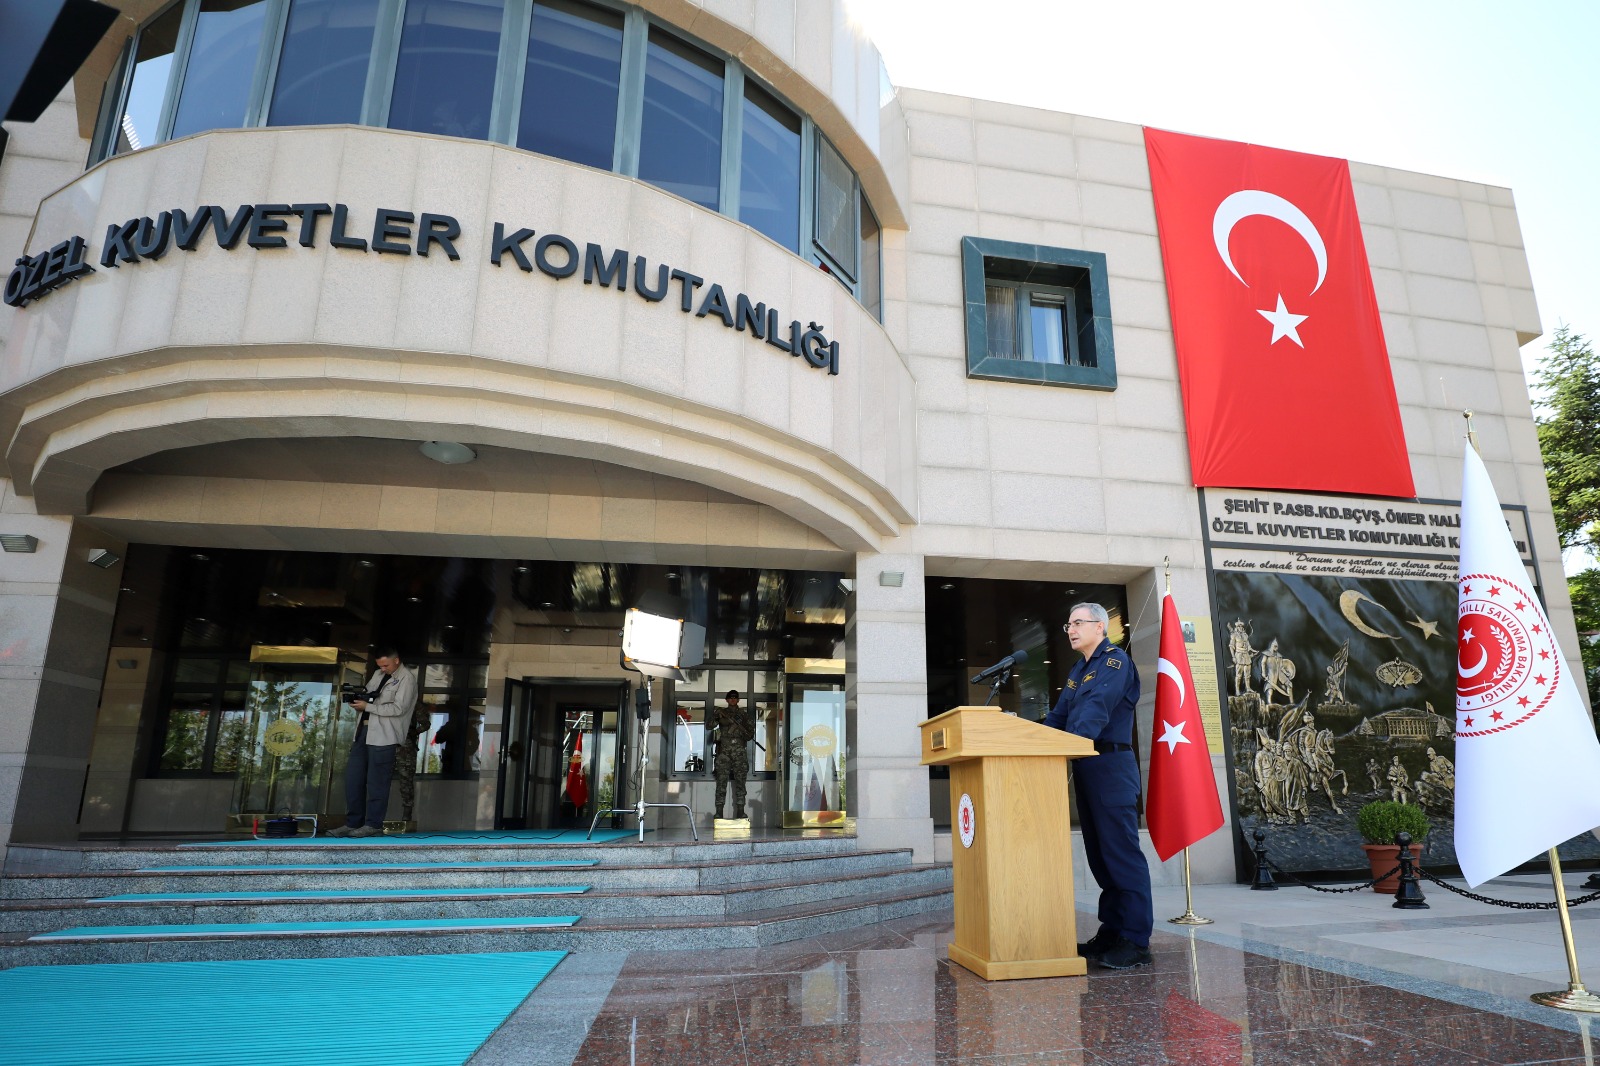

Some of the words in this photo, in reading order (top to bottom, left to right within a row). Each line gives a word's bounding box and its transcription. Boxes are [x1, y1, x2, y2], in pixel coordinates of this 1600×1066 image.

[4, 235, 96, 307] ÖZEL
[100, 203, 461, 268] KUVVETLER
[490, 222, 840, 375] KOMUTANLIĞI
[1224, 498, 1269, 514] ŞEHİT
[1386, 509, 1427, 525] ÖMER
[1212, 517, 1253, 534] ÖZEL
[1257, 522, 1346, 541] KUVVETLER
[1349, 529, 1446, 548] KOMUTANLIĞI
[1223, 559, 1256, 568] teslim
[1260, 560, 1293, 570] olmak
[1311, 563, 1345, 573] esarete
[1349, 566, 1386, 576] düşmek
[1349, 558, 1383, 567] şartlar
[1401, 560, 1430, 569] olursa
[1461, 603, 1486, 614] MİLLİ
[1487, 607, 1527, 653] SAVUNMA
[1481, 656, 1527, 703] BAKANLIĞI
